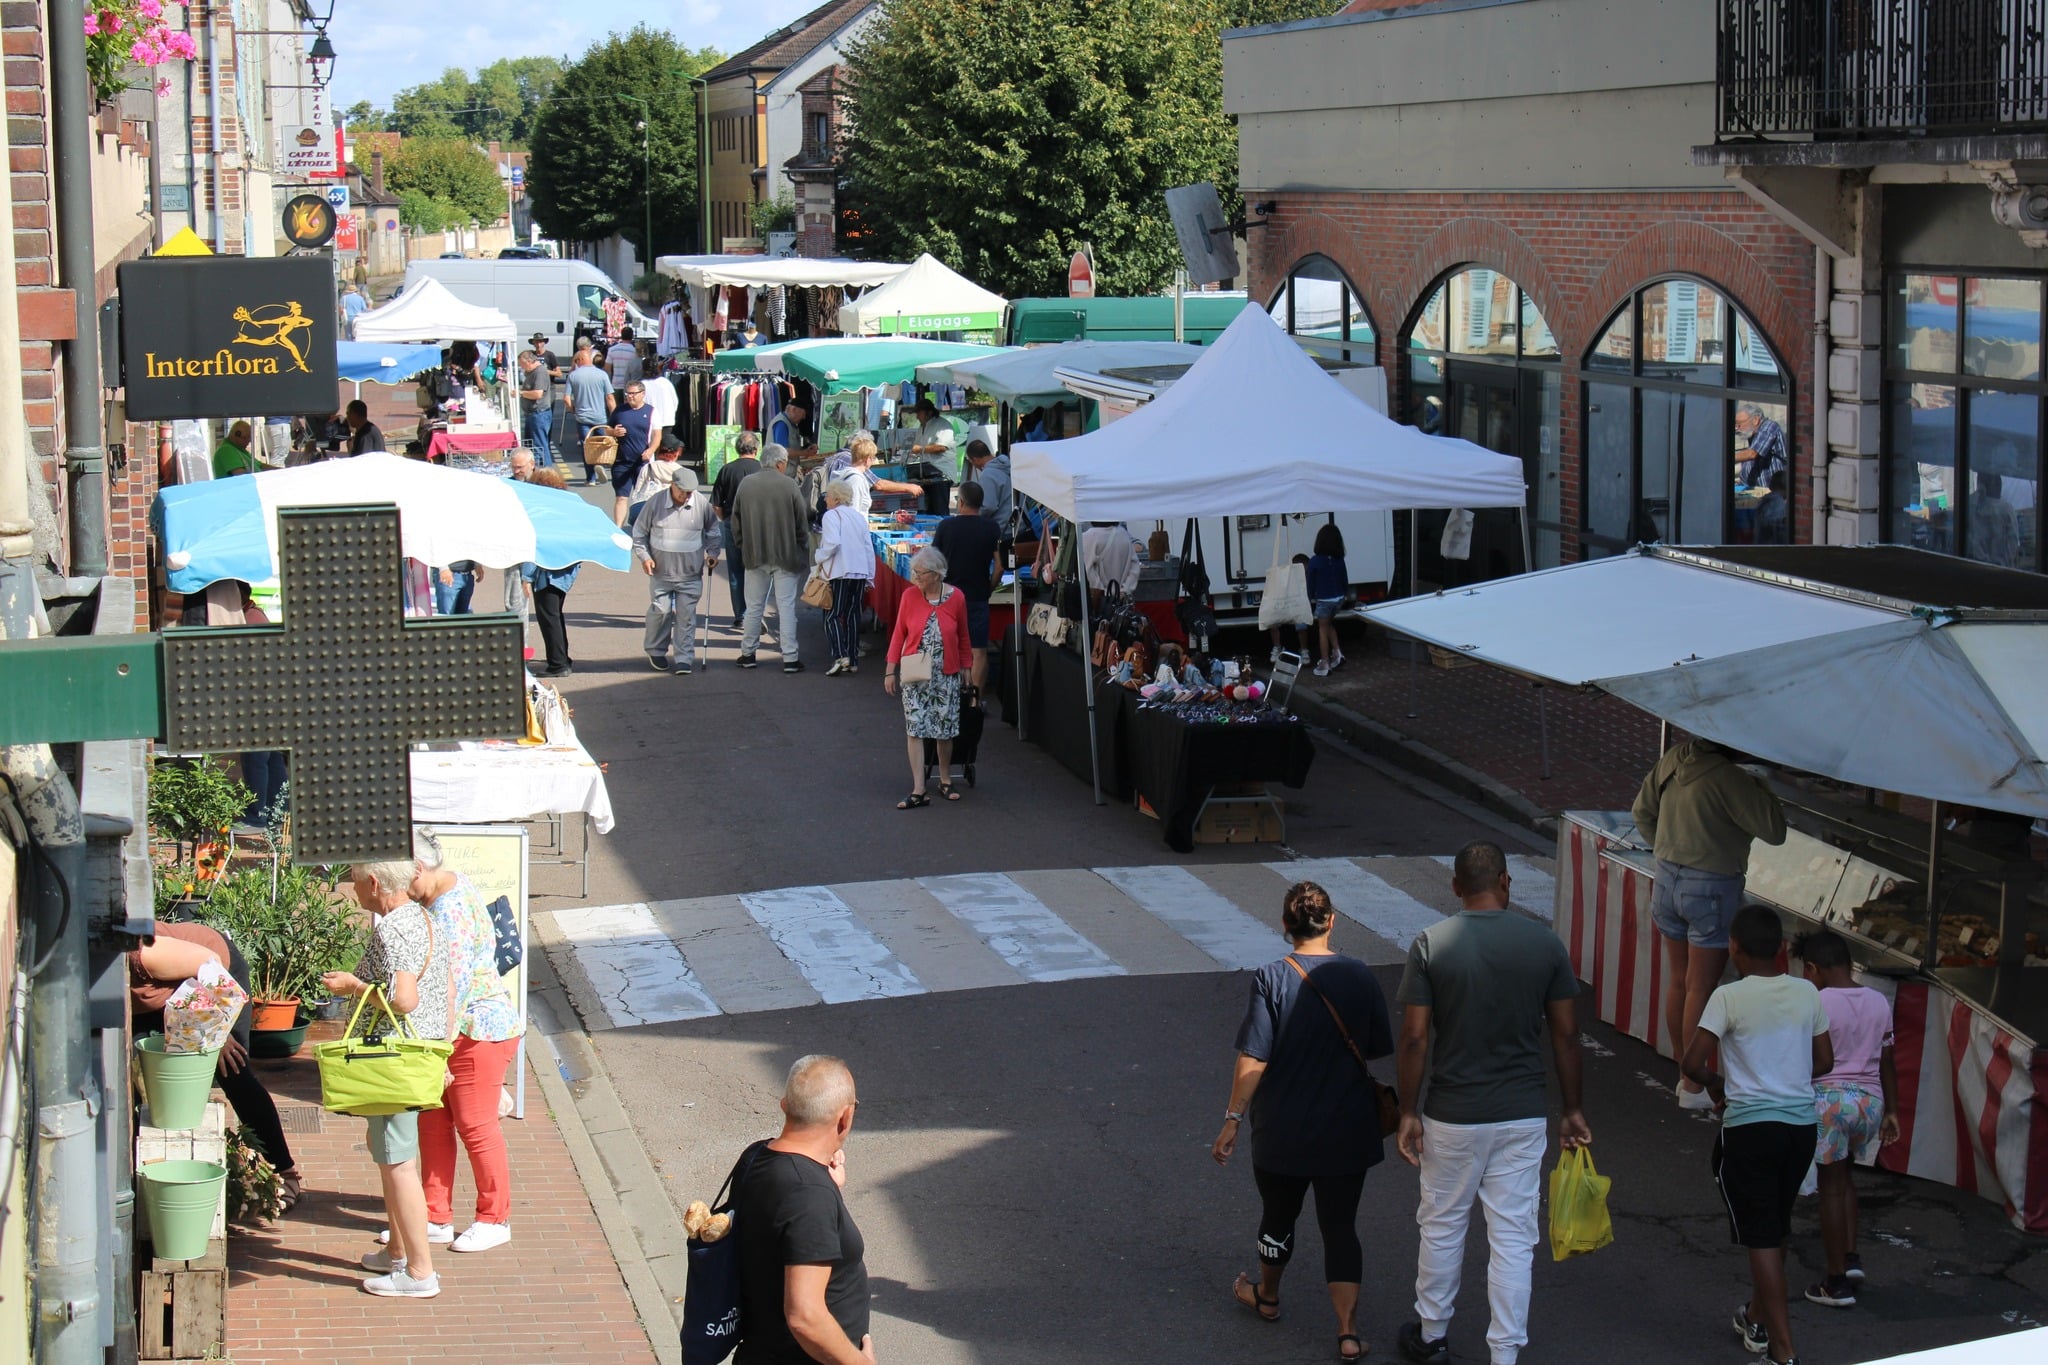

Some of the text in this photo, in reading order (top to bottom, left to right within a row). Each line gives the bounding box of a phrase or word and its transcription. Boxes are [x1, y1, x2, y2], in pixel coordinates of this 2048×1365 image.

[288, 150, 314, 158] CAFÉ
[287, 159, 333, 167] L'ÉTOILE
[908, 315, 972, 328] Elagage
[144, 348, 280, 378] Interflora
